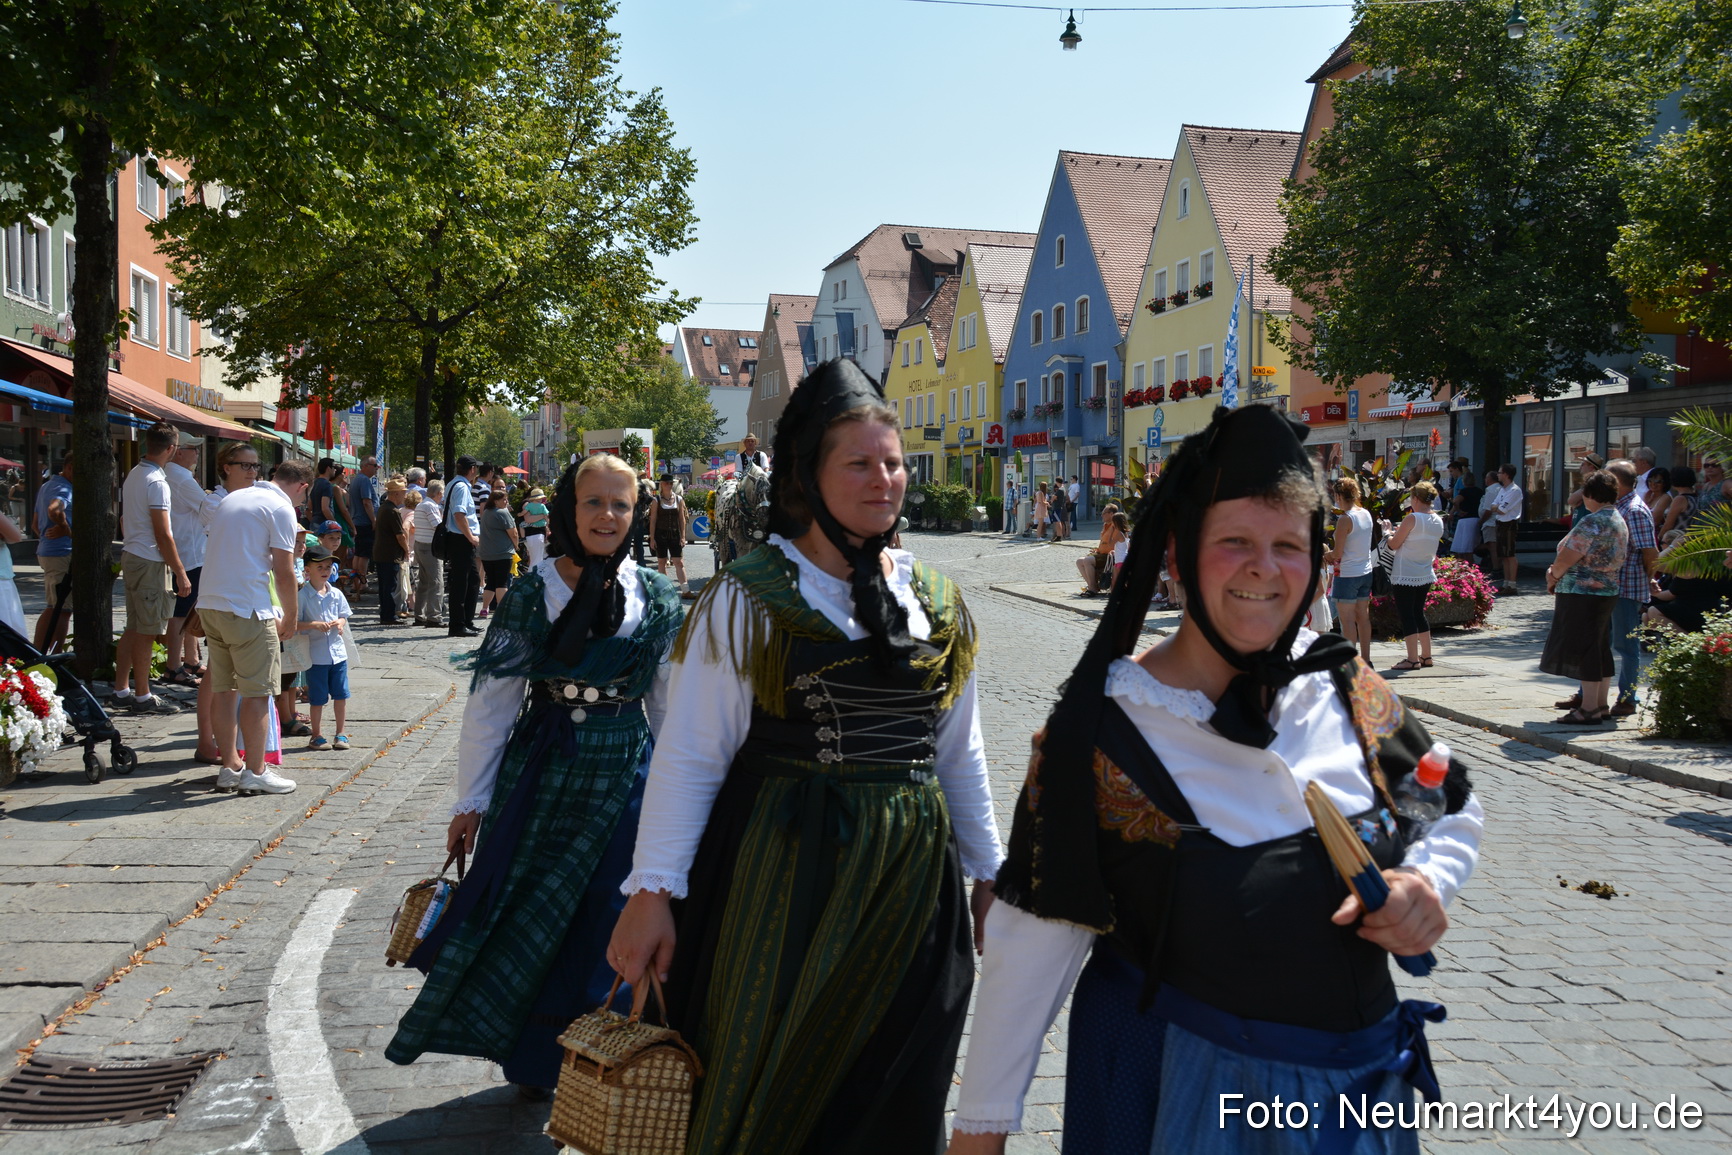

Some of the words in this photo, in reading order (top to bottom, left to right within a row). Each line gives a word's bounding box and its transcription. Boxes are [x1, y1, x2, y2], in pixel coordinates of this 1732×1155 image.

[908, 380, 922, 392] HOTEL
[1327, 405, 1341, 414] DER
[1350, 394, 1356, 415] P
[1150, 429, 1158, 445] P
